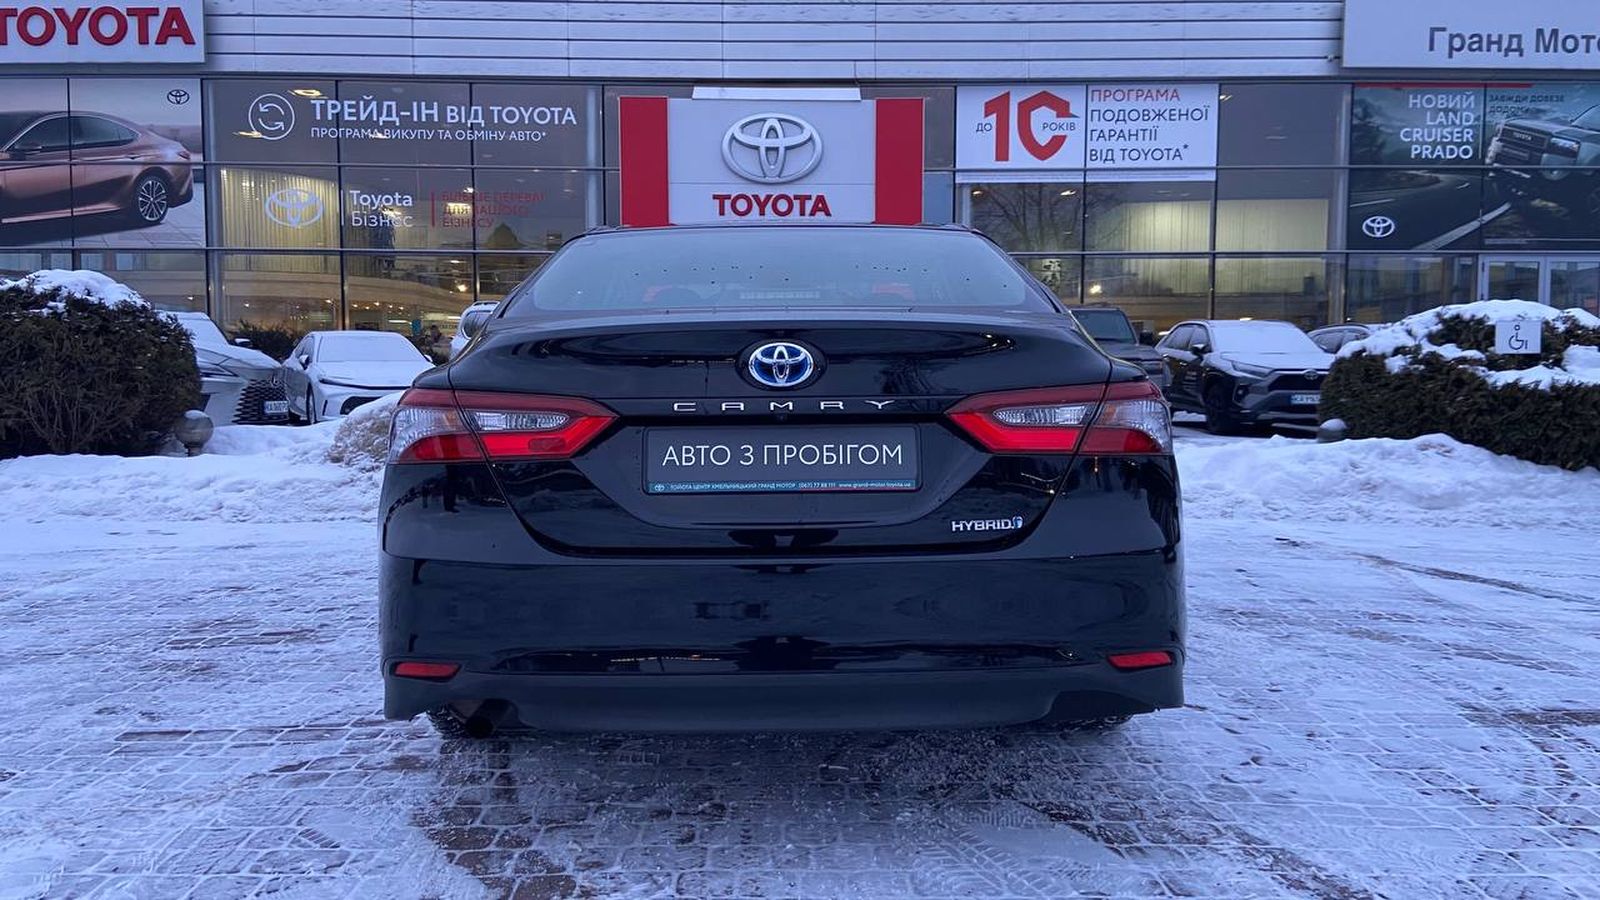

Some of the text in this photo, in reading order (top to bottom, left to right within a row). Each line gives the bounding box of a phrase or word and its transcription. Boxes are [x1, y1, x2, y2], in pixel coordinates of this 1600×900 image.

[0, 6, 196, 46] TOYOTA
[1428, 26, 1600, 59] Гранд Мот
[1090, 89, 1181, 102] ПРОГРАМА
[1409, 91, 1475, 109] НОВИЙ
[311, 94, 577, 127] ТРЕЙД-ІН ВІД TOYOTA
[1090, 105, 1210, 124] ПОДОВЖЕНОЇ
[1426, 112, 1474, 126] LAND
[311, 127, 384, 139] ПРОГРАМА
[385, 129, 434, 141] ВИКУПУ
[437, 130, 452, 140] ТА
[456, 130, 506, 141] ОБМІНУ
[975, 122, 992, 133] ДО
[1042, 121, 1076, 132] РОКІВ
[1089, 125, 1159, 142] ГАРАНТІЇ
[1400, 127, 1474, 143] CRUISER
[1089, 148, 1115, 164] ВІД
[1411, 145, 1473, 159] PRADO
[350, 190, 413, 210] Toyota
[712, 193, 832, 217] TOYOTA
[351, 211, 413, 228] Бізнес
[673, 399, 895, 411] CAMRY
[662, 444, 731, 466] АВТО
[763, 444, 902, 466] ПРОБІГОМ
[951, 518, 1012, 532] HYBRID
